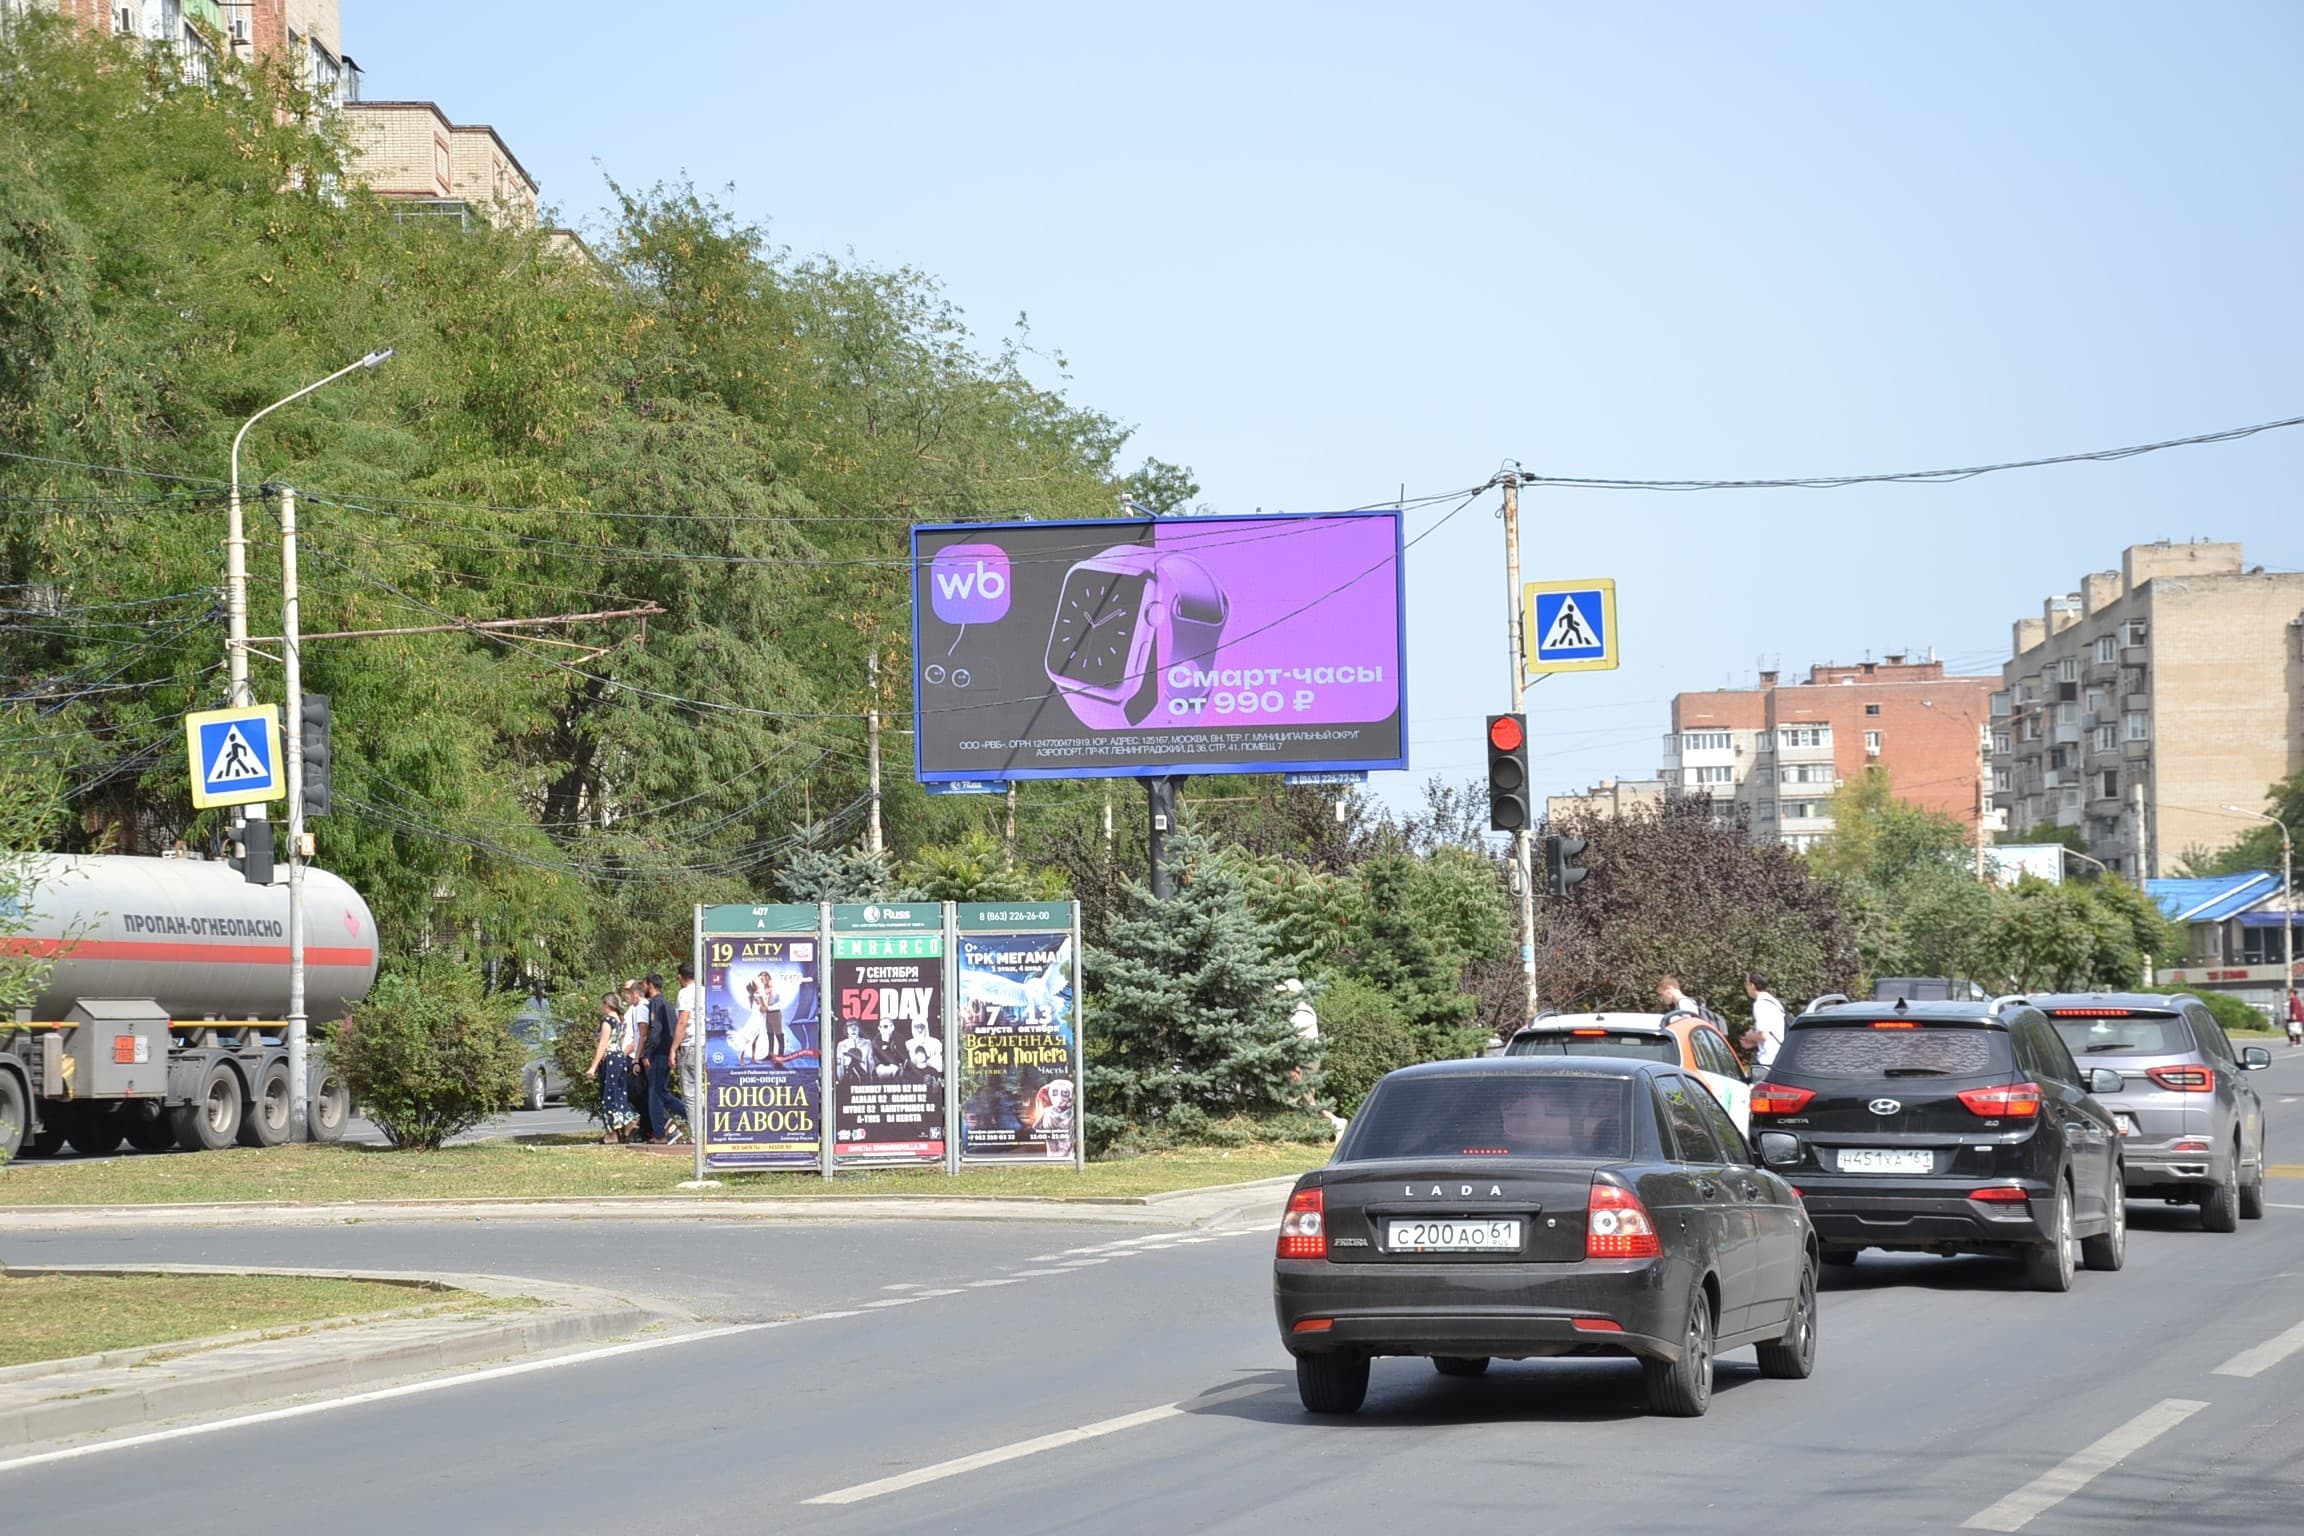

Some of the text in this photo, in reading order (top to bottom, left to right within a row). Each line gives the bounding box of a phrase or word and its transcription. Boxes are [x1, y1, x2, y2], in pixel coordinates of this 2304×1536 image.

[936, 560, 1005, 600] wb
[1167, 665, 1383, 690] Смарт-часы
[1168, 690, 1315, 716] от 990 ₽
[959, 740, 980, 750] ООО
[1008, 739, 1031, 749] ОГРН
[1253, 730, 1331, 742] МУНИЦИПАЛЬНЫЙ
[1332, 730, 1361, 740] ОКРУГ
[1085, 746, 1109, 756] ПР-КТ
[752, 907, 768, 916] 407
[883, 908, 911, 920] Russ
[979, 911, 1050, 922] 8 (863) 226-26-00
[123, 914, 283, 938] ПРОПАН-ОГНЕОПАСНО
[711, 943, 733, 962] 19
[742, 943, 783, 956] ДГТУ
[836, 939, 939, 955] EMBARGO
[964, 952, 994, 965] ТРК
[855, 966, 919, 984] 7 СЕНТЯБРЯ
[842, 987, 933, 1021] 52DAY
[986, 1003, 1053, 1025] 7 13
[740, 1076, 787, 1086] рок-опера
[717, 1086, 809, 1108] ЮНОНА
[713, 1110, 814, 1132] И АВОСЬ
[1405, 1185, 1502, 1196] LADA
[1490, 1222, 1512, 1239] 61
